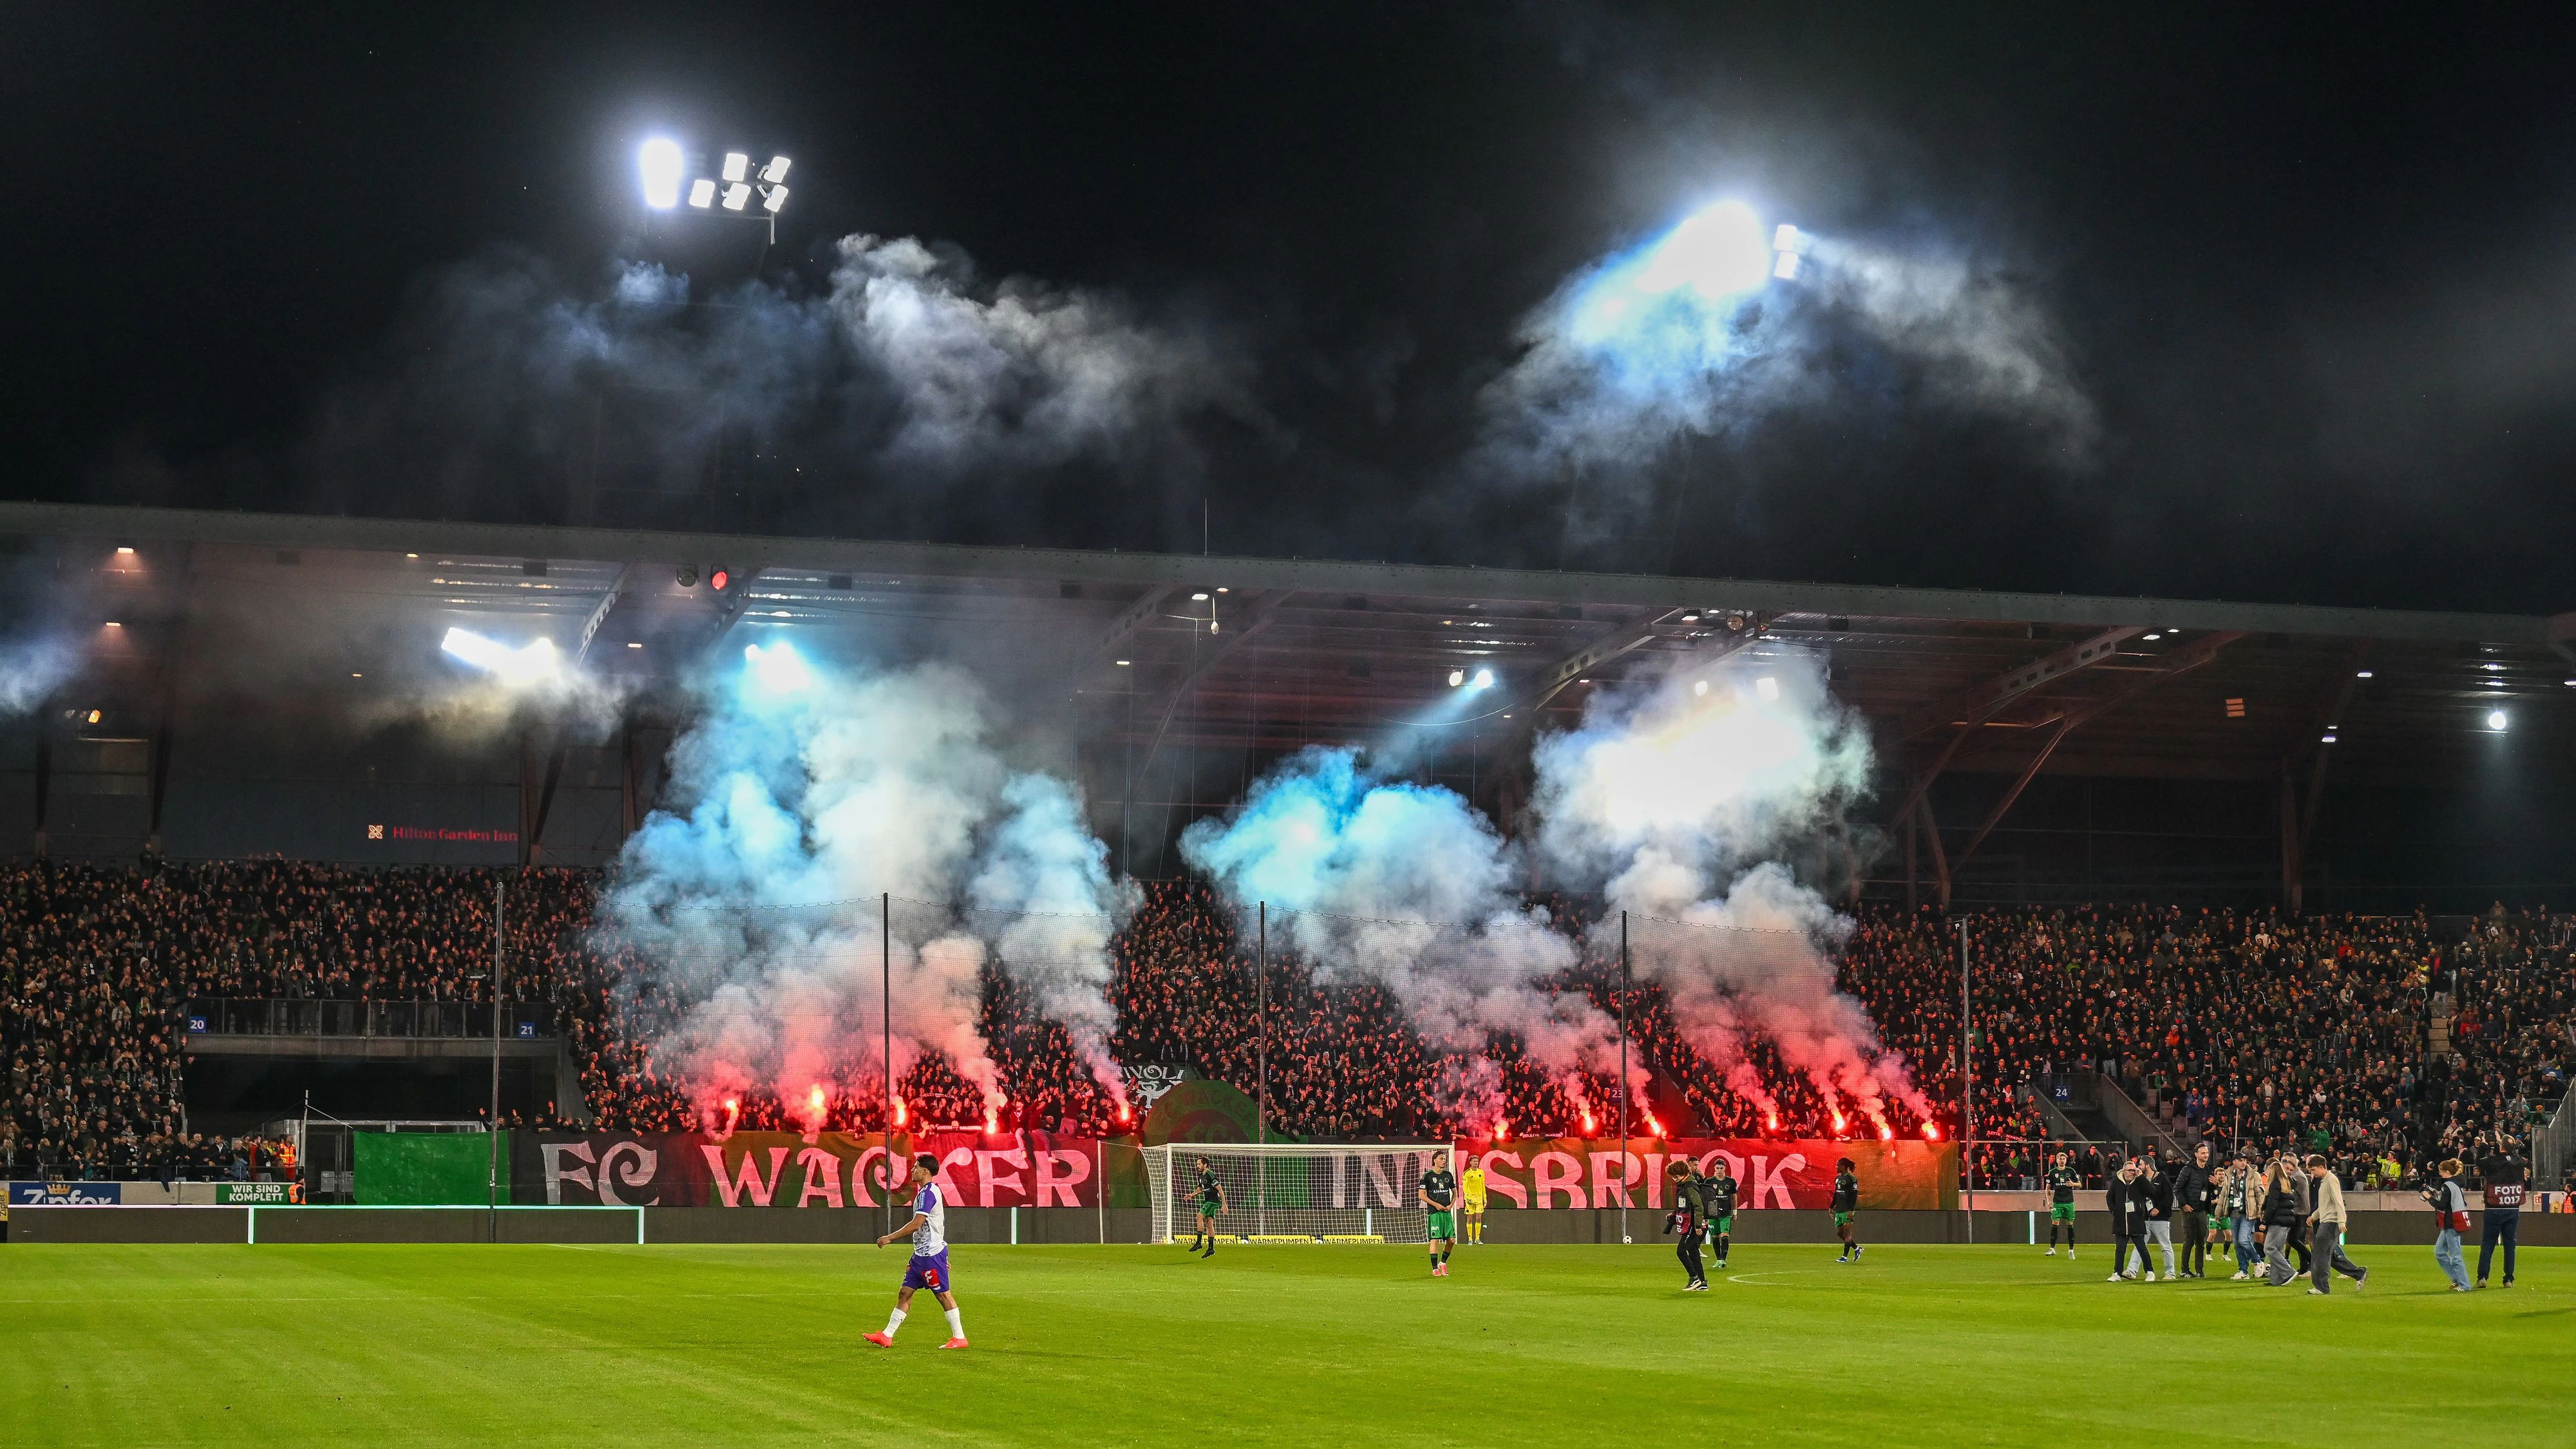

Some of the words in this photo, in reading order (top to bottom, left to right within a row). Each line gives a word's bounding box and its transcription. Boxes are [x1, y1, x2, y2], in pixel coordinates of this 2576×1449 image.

[393, 827, 435, 838] Hilton
[439, 829, 489, 840] Garden
[494, 830, 518, 841] Inn
[190, 1019, 205, 1030] 20
[520, 1025, 533, 1035] 21
[1123, 1065, 1185, 1079] IVOLI
[1611, 1090, 1622, 1098] 23
[2056, 1088, 2068, 1097] 24
[540, 1141, 659, 1206] FC
[232, 1184, 252, 1193] WIR
[255, 1184, 281, 1193] SIND
[2494, 1185, 2523, 1195] FOTO
[229, 1193, 284, 1202] KOMPLETT
[2499, 1196, 2520, 1204] 1017
